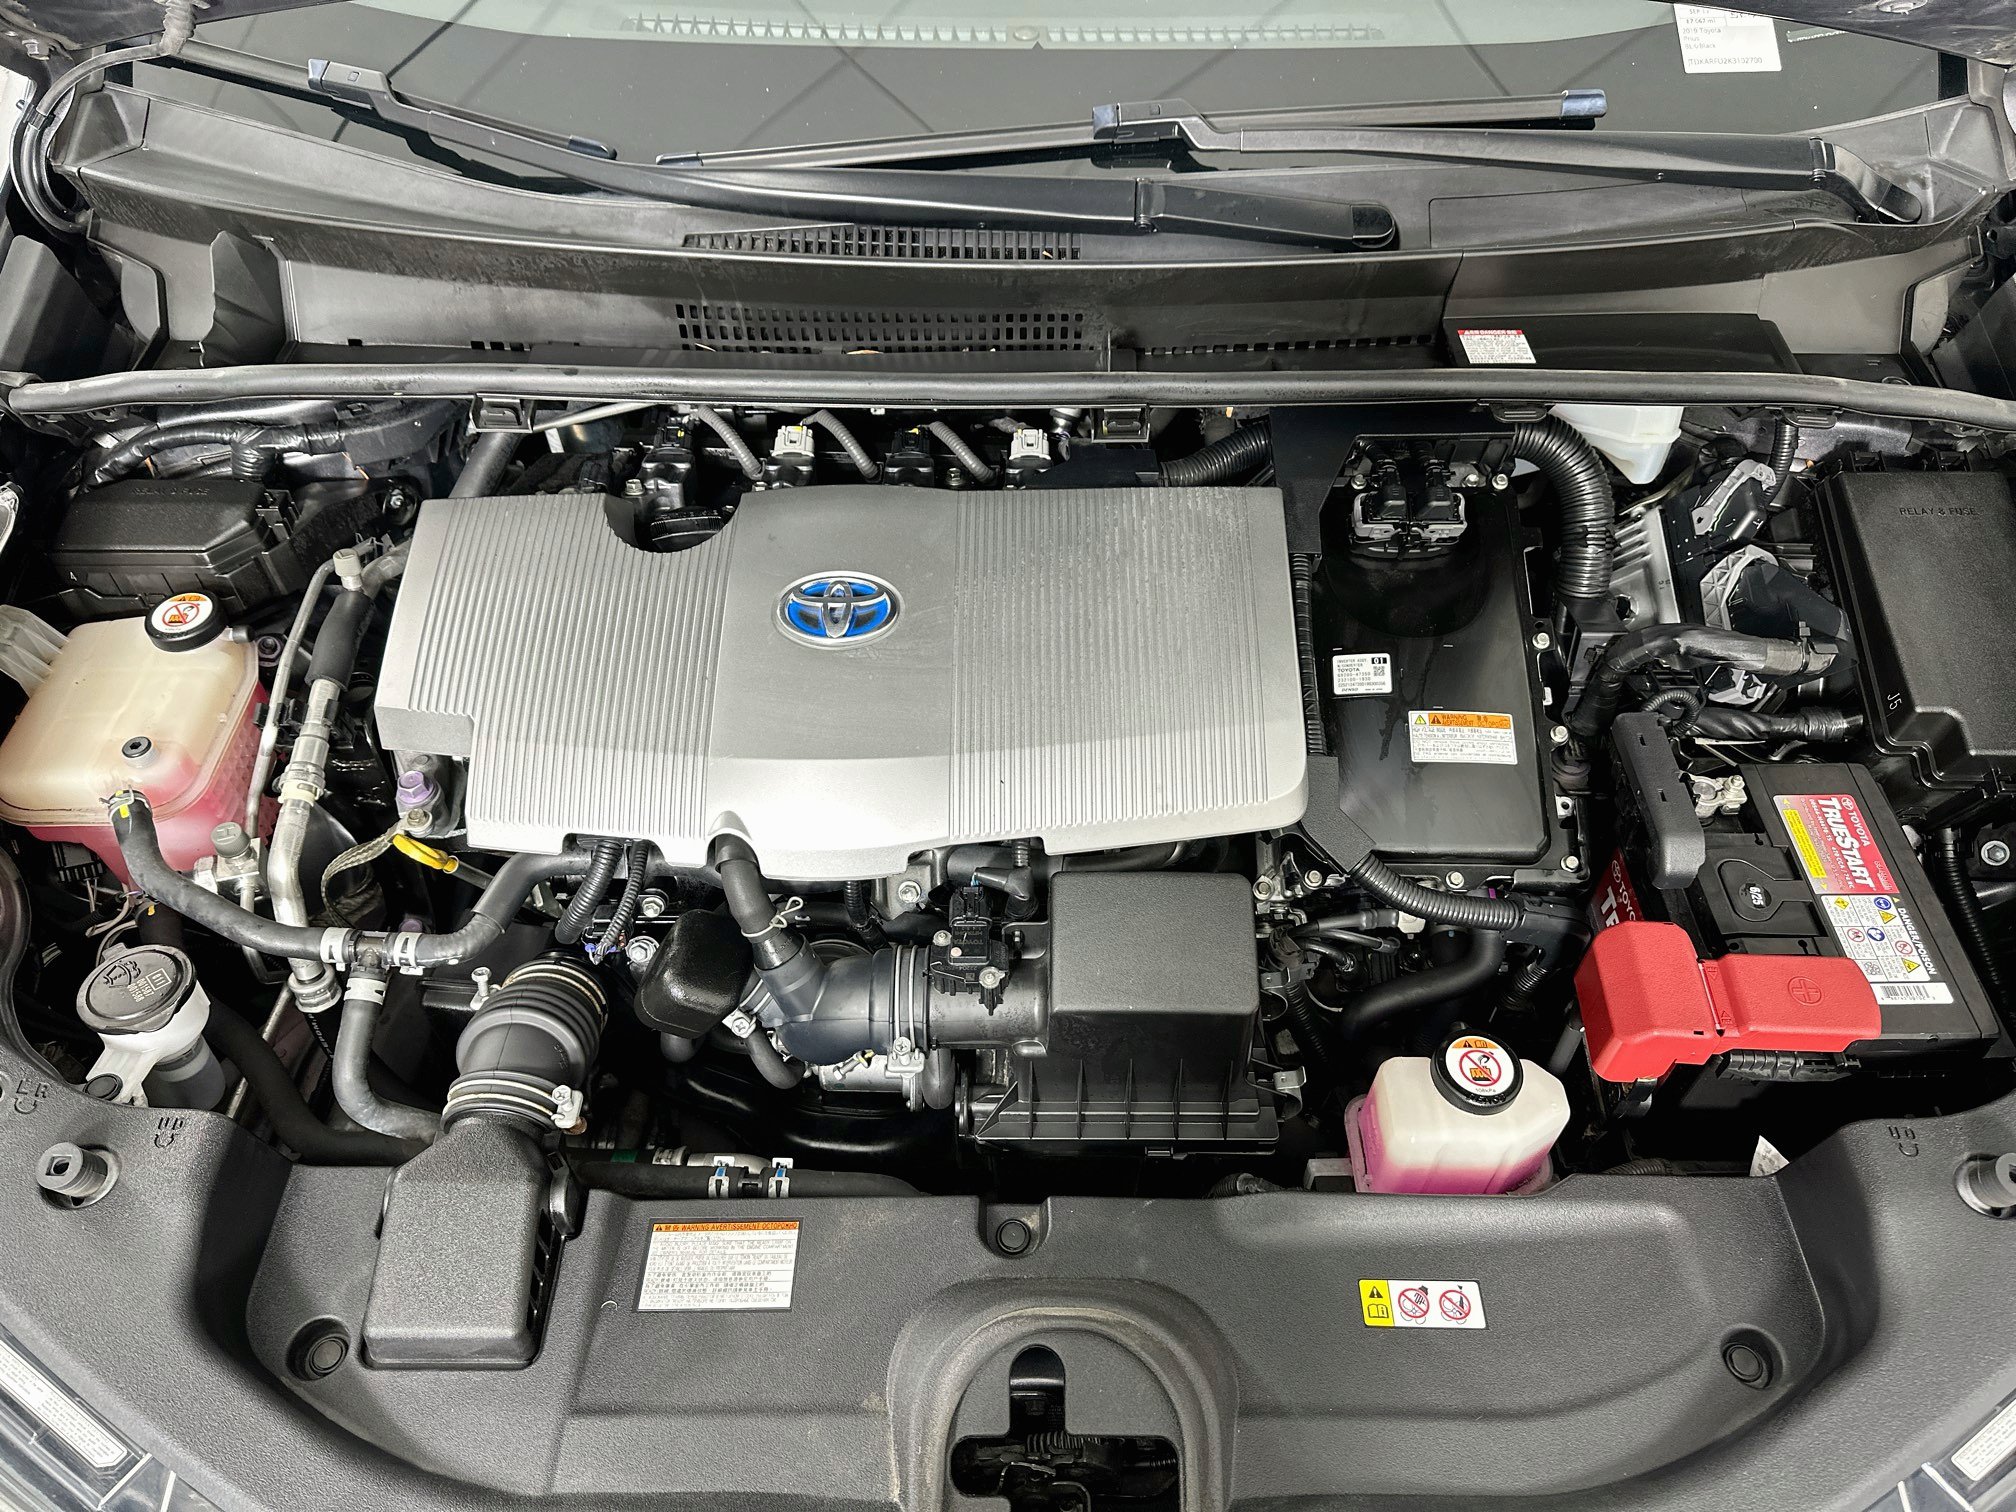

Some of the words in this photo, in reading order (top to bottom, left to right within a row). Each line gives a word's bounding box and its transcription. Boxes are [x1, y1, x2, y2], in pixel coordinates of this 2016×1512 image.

[1900, 508, 1934, 516] RELAY
[1938, 508, 1946, 516] &
[1949, 508, 1978, 516] FUSE
[1848, 811, 1870, 846] TOYOTA
[1750, 886, 1764, 906] 6/25
[1898, 907, 1937, 974] DANGER/POISON
